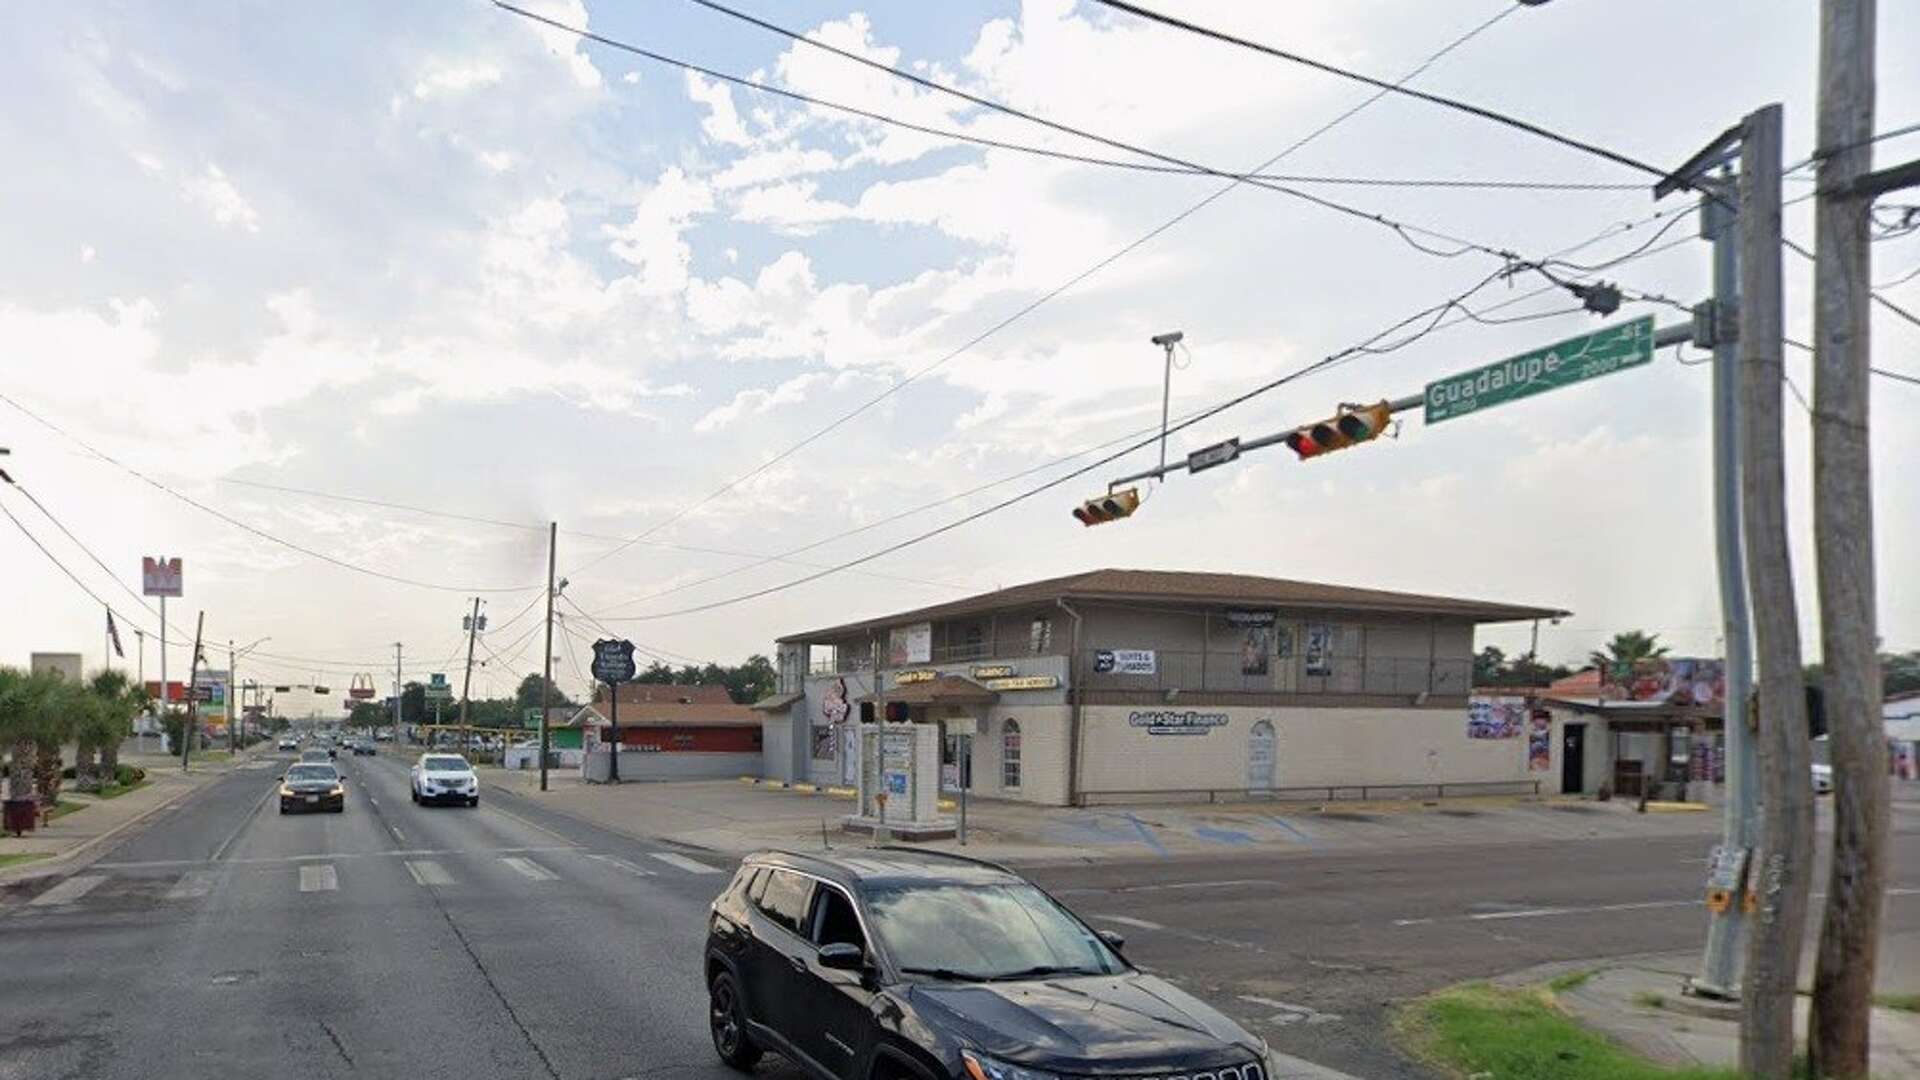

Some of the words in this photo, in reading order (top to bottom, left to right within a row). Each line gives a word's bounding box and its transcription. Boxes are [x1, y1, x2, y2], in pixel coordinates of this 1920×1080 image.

[1429, 351, 1561, 408] Guadalupe
[1129, 712, 1155, 726] Gold
[1160, 712, 1184, 725] Star
[1185, 712, 1229, 726] Finance
